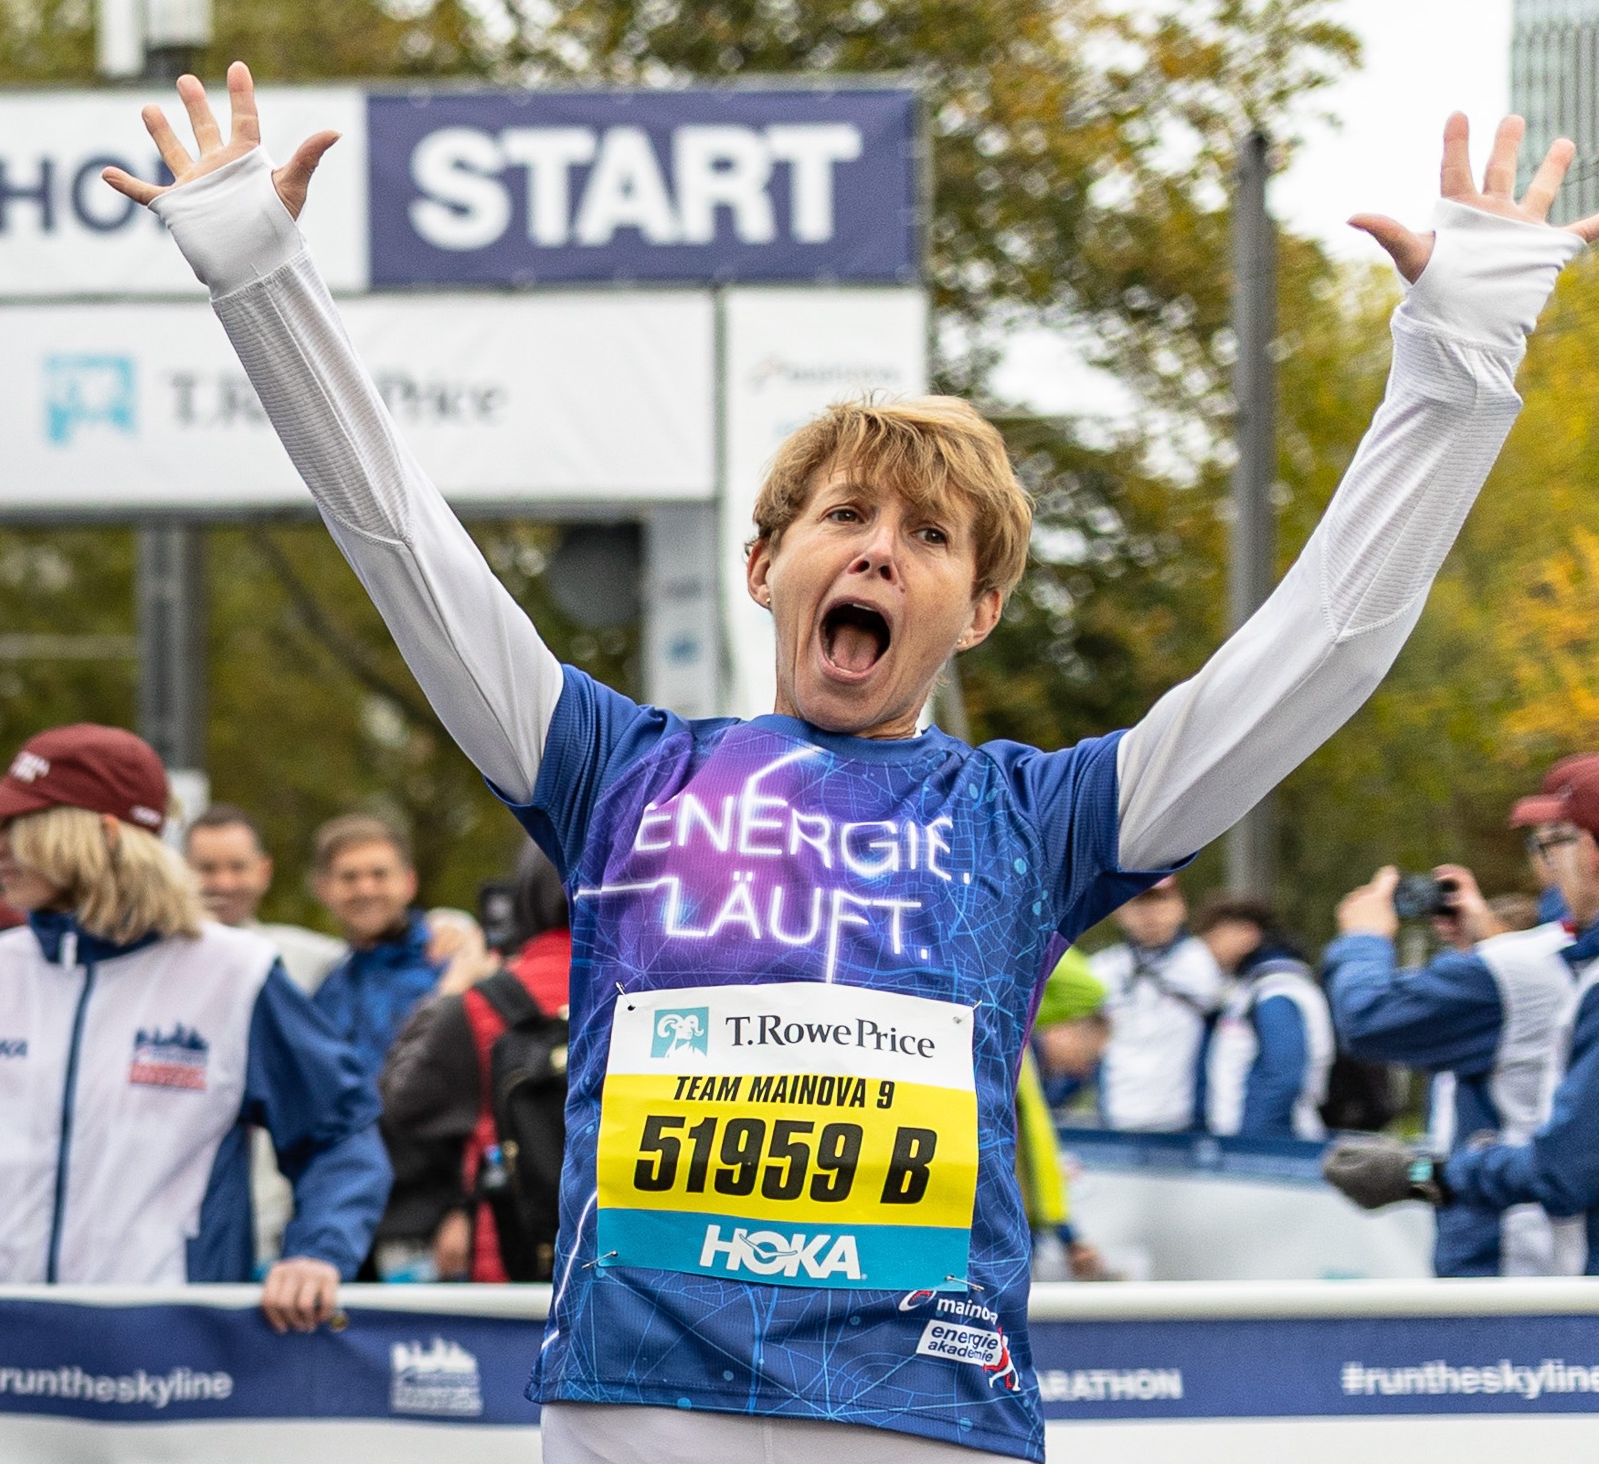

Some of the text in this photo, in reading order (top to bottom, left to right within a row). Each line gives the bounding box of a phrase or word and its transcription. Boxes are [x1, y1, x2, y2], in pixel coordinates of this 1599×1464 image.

[411, 122, 863, 250] START
[675, 1075, 894, 1110] TEAM MAINOVA 9
[633, 1115, 938, 1204] 51959 B
[699, 1225, 861, 1281] HOKA
[927, 1340, 994, 1362] akademie
[931, 1326, 998, 1350] energie
[1039, 1369, 1183, 1401] ARATHON
